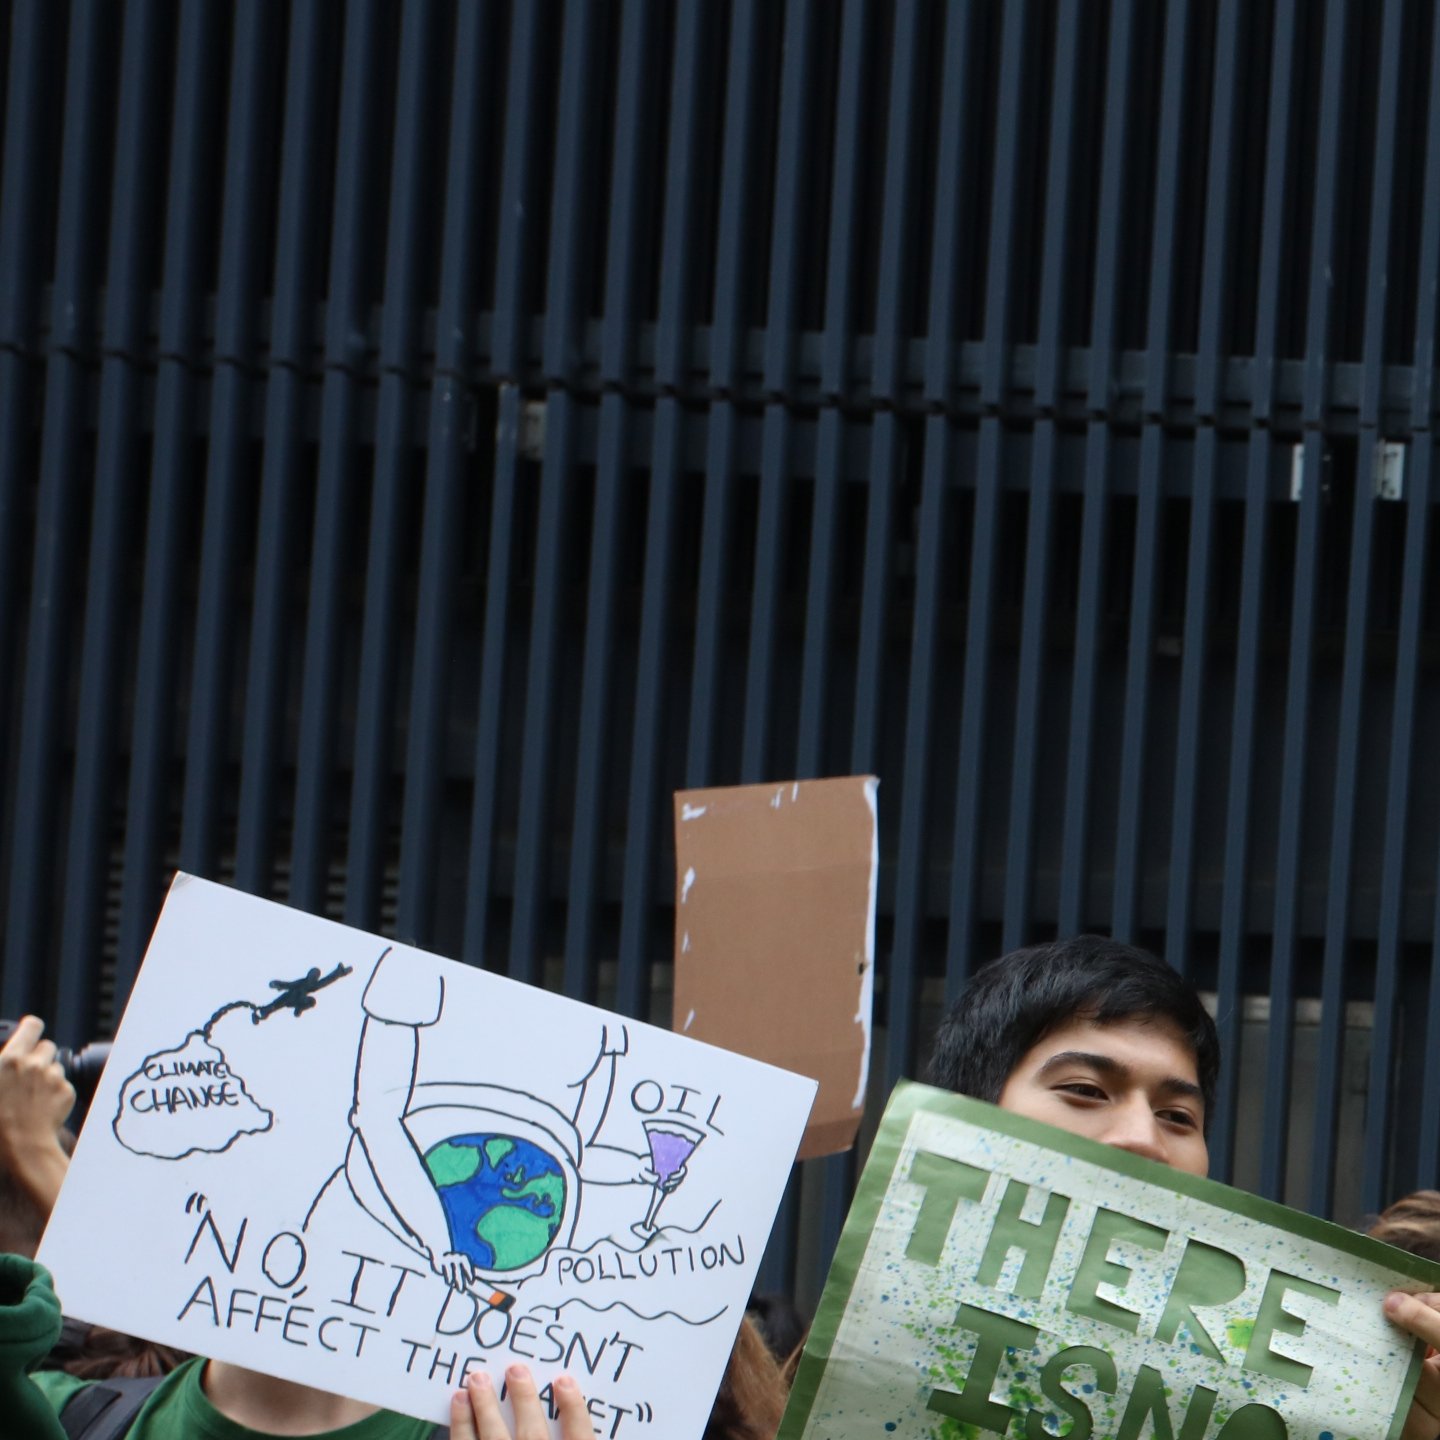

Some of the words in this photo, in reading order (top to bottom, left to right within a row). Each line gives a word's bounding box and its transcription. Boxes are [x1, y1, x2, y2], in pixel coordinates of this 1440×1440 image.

[130, 1081, 240, 1114] CHANGE
[143, 1059, 228, 1082] CLIMATE
[630, 1079, 726, 1137] OIL
[558, 1234, 745, 1286] POLLUTION
[903, 1151, 1342, 1388] THERE
[177, 1275, 381, 1358] AFFECT
[400, 1339, 487, 1390] THE
[331, 1250, 427, 1317] IT
[435, 1283, 645, 1382] DOESN'T
